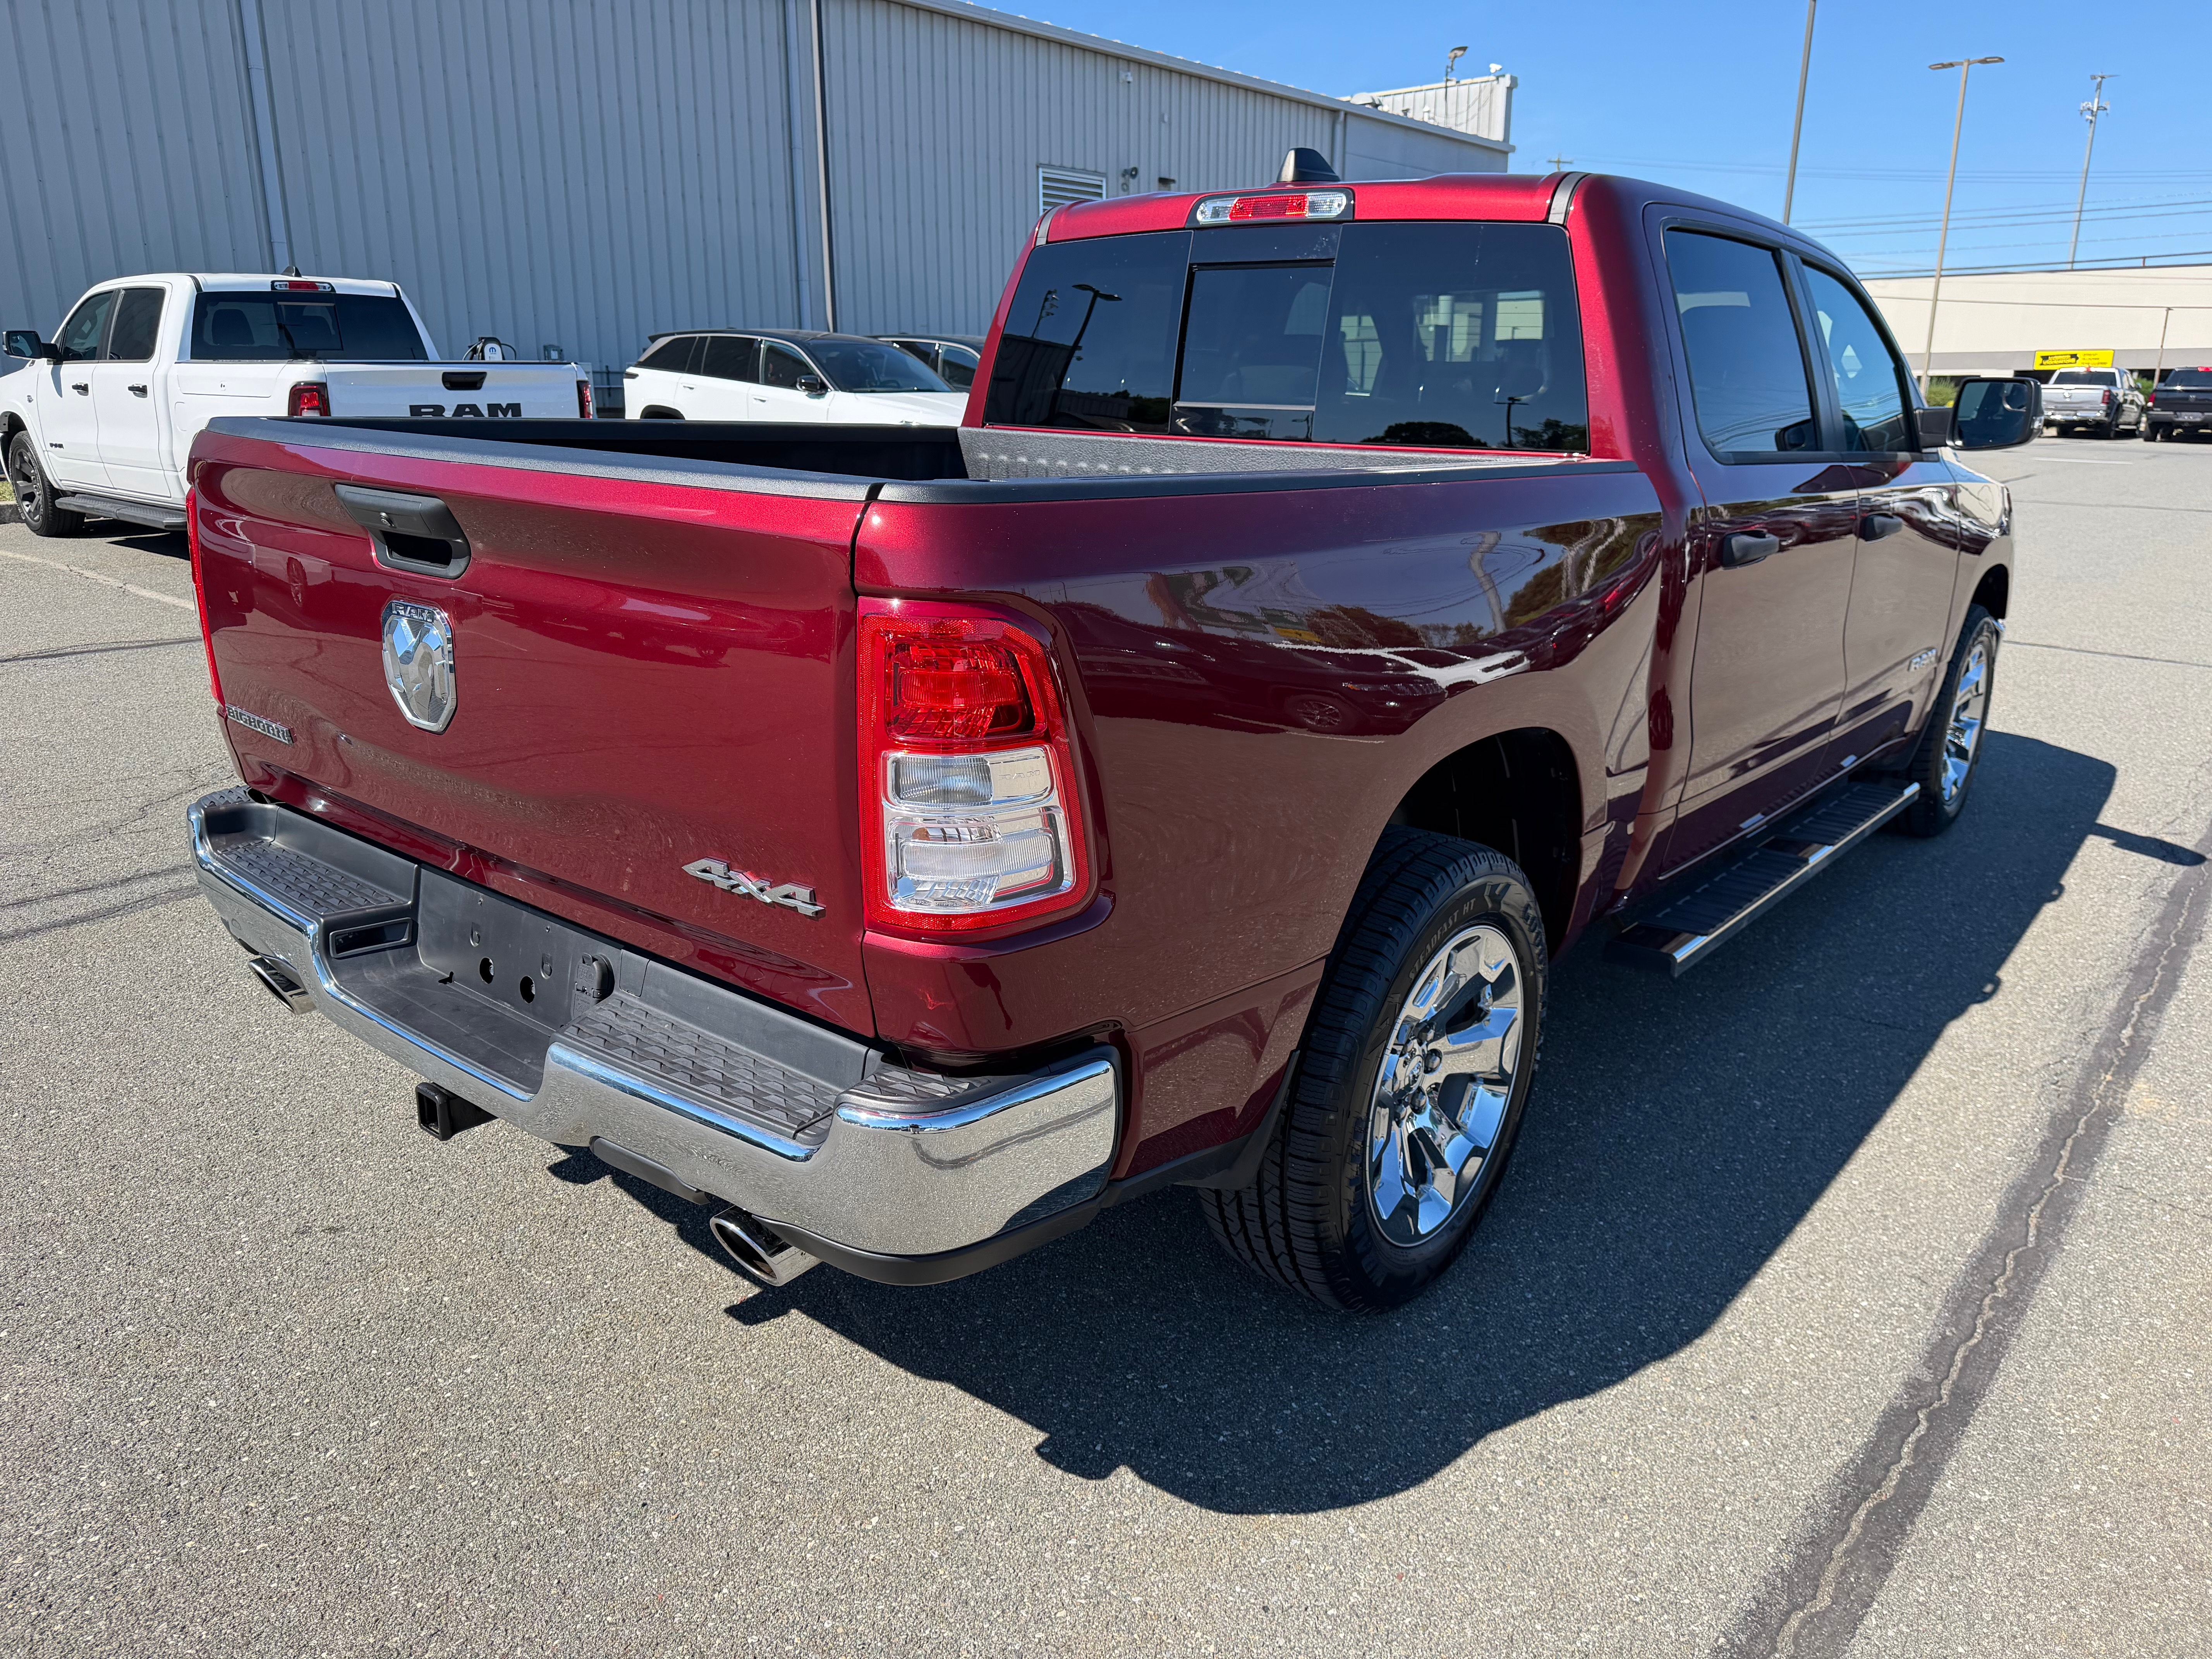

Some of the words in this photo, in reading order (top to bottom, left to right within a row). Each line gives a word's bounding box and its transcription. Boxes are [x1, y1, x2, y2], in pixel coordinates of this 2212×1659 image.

[409, 403, 522, 417] RAM
[392, 603, 434, 623] RAM
[998, 770, 1040, 780] RAM
[1408, 910, 1459, 982] STEADFAST
[1463, 898, 1476, 915] HT
